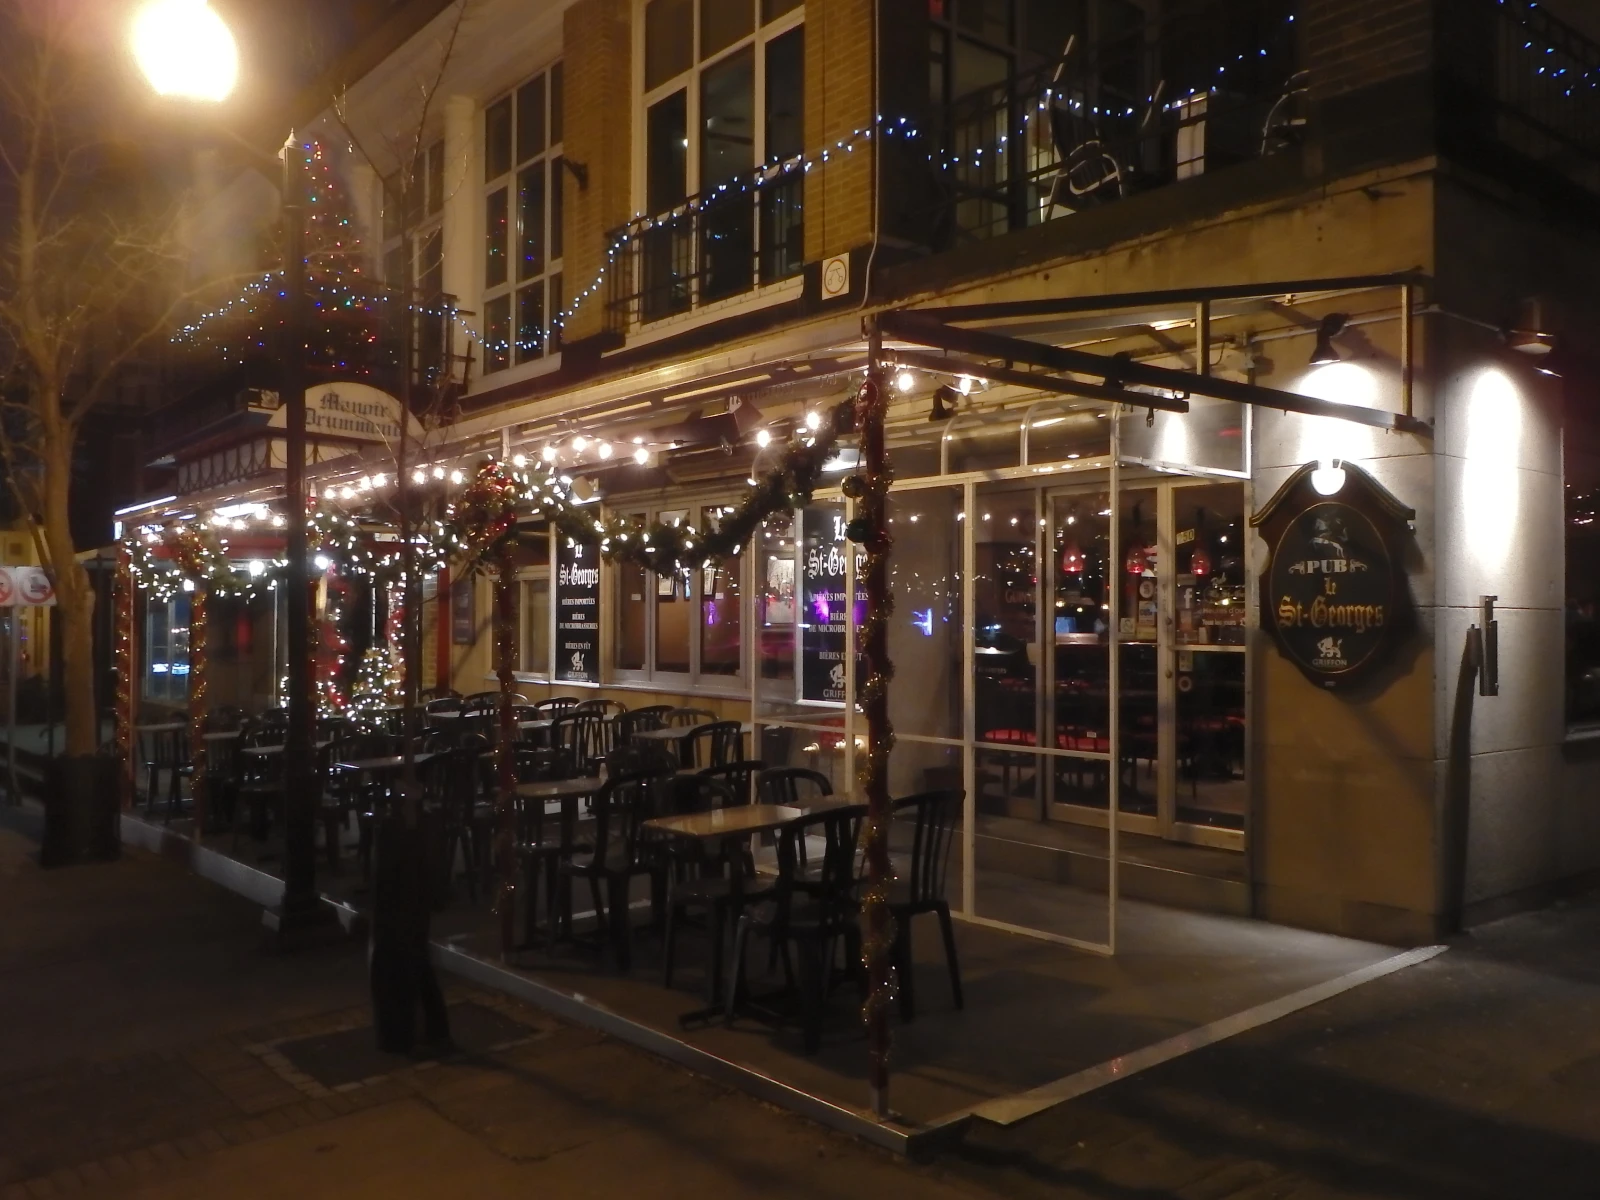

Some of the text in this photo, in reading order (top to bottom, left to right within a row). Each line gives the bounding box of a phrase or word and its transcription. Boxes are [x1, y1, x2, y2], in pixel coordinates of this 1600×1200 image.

[559, 562, 599, 589] St-Georges
[1307, 559, 1347, 574] PUB
[1279, 595, 1384, 634] St-Georges
[1312, 658, 1348, 667] GRIFFON
